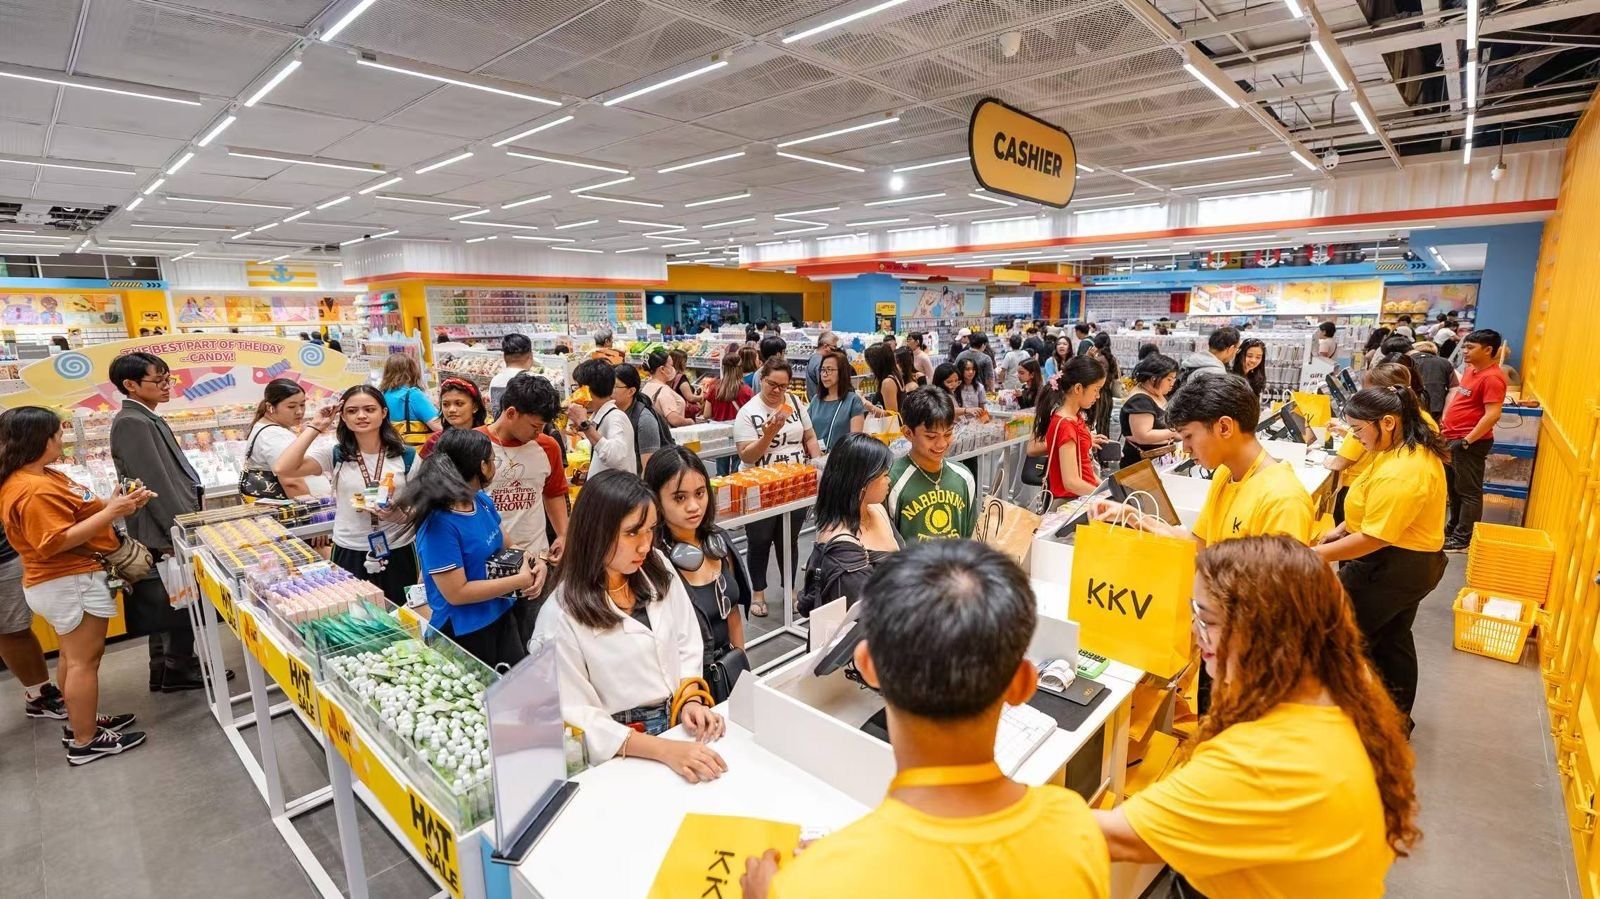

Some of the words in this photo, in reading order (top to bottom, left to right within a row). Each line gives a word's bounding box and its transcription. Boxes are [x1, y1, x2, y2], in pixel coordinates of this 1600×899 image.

[993, 131, 1063, 178] CASHIER
[151, 342, 185, 354] BEST
[186, 340, 218, 350] PART
[219, 340, 234, 349] OF
[237, 341, 260, 350] THE
[263, 343, 283, 354] DAY
[1086, 577, 1154, 620] KKV
[297, 693, 316, 721] SALE
[409, 793, 453, 864] HOT
[424, 842, 459, 894] SALE
